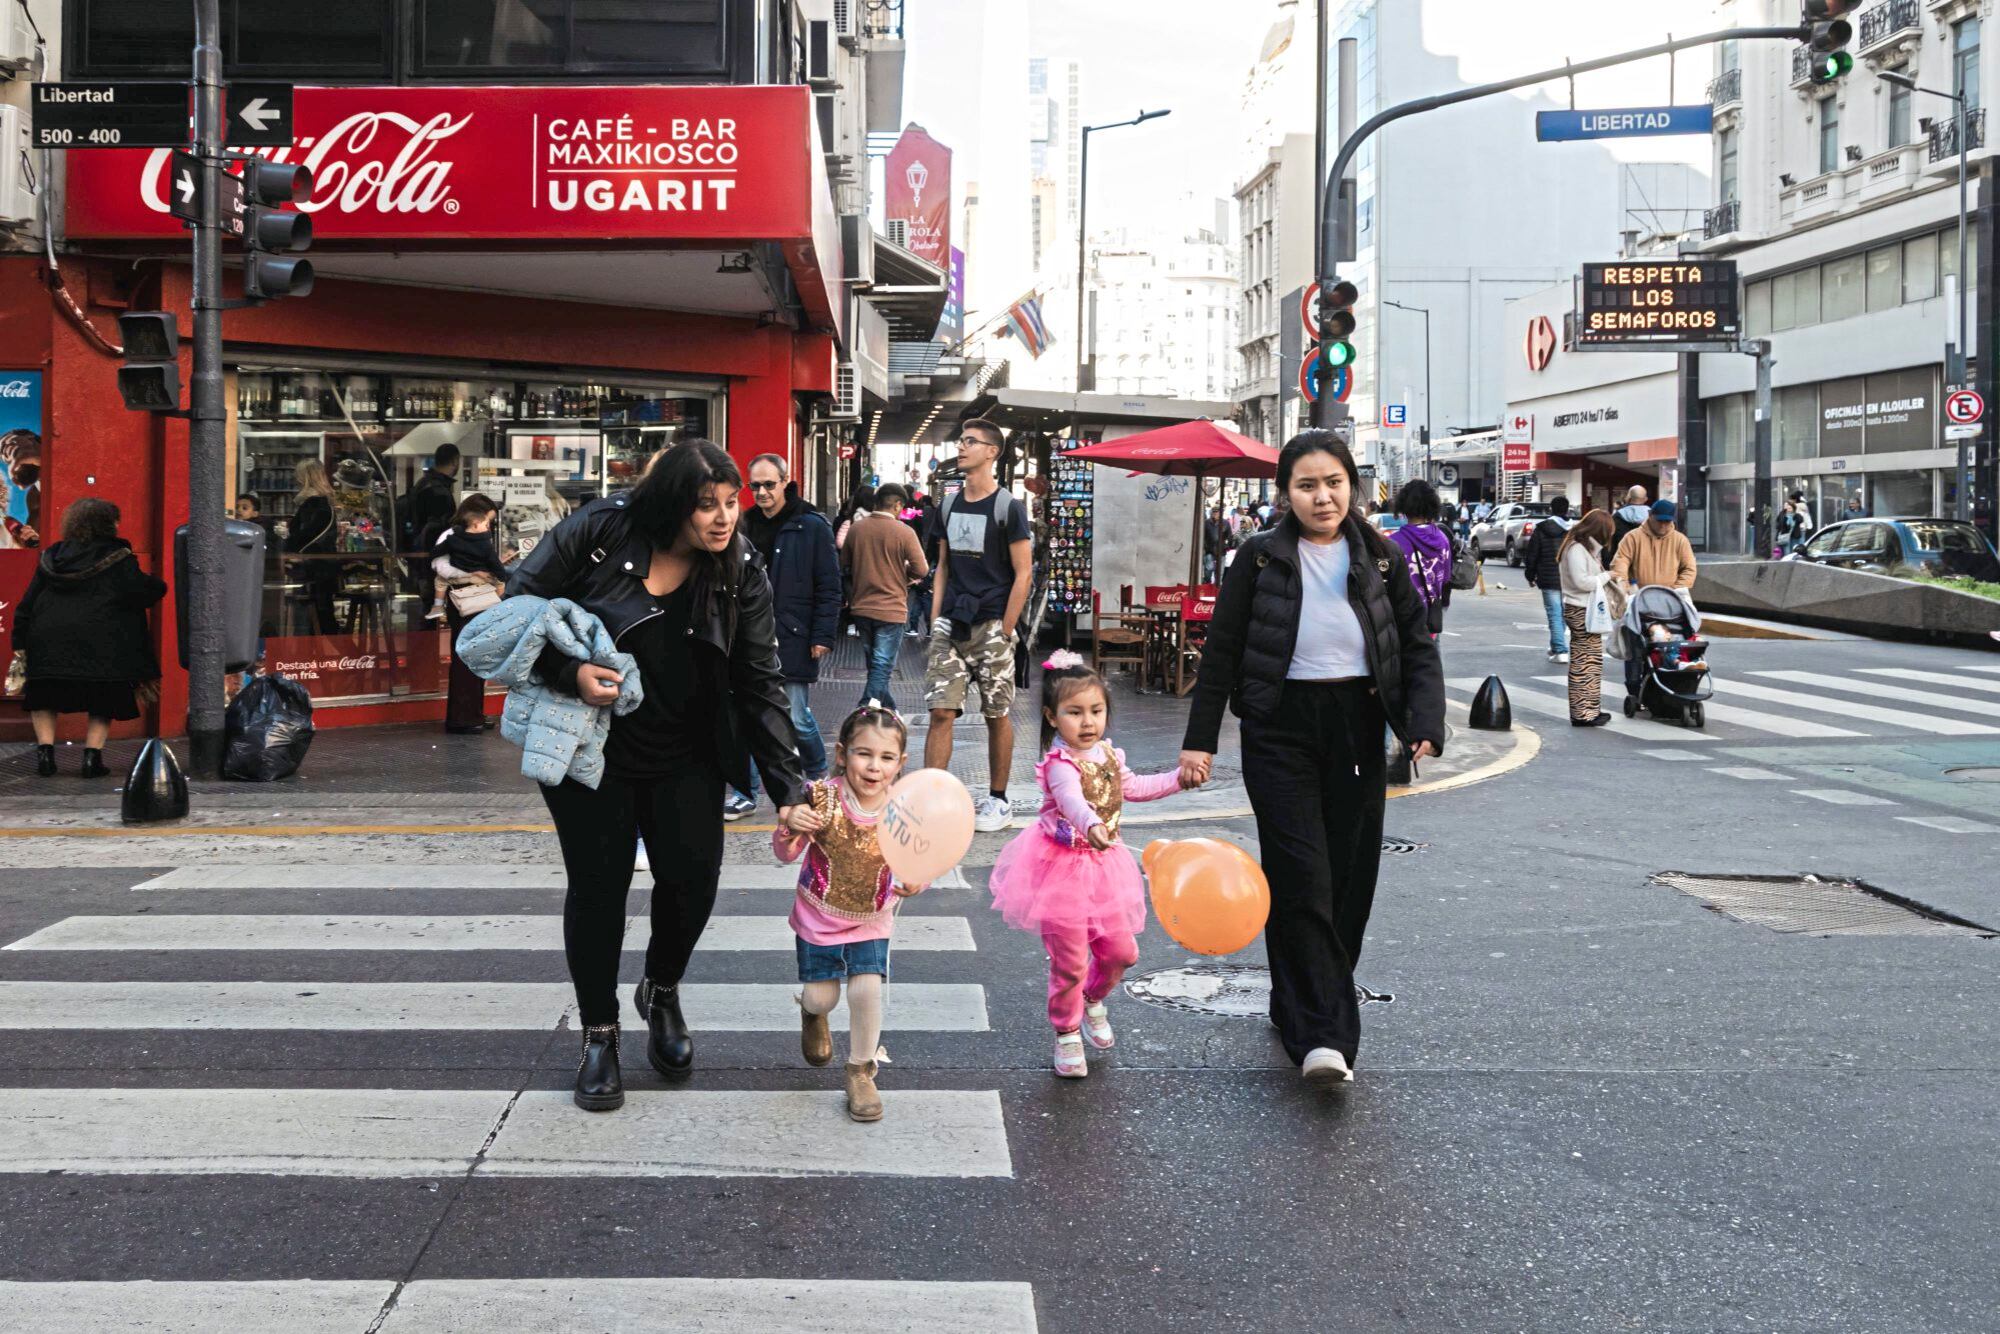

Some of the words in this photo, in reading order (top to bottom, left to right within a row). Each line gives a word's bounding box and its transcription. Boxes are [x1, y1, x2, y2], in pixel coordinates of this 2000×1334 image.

[40, 88, 114, 103] Libertad
[548, 113, 634, 141] CAFÉ
[671, 119, 736, 140] BAR
[1581, 113, 1671, 132] LIBERTAD
[40, 128, 73, 143] 500
[88, 128, 121, 143] 400
[548, 142, 739, 165] MAXIKIOSCO
[548, 179, 736, 211] UGARIT
[910, 215, 925, 224] LA
[1604, 267, 1701, 285] RESPETA
[1632, 289, 1674, 307] LOS
[1590, 310, 1717, 329] SEMAFOROS
[1825, 405, 1863, 419] OFICINAS
[1866, 403, 1878, 414] EN
[1880, 398, 1924, 412] ALQUILER
[1553, 412, 1580, 428] ABIERTO
[1580, 410, 1588, 424] 24
[276, 659, 317, 671] Destapá
[318, 660, 337, 669] una
[338, 655, 376, 671] Coca-Cola
[282, 671, 299, 681] ien
[299, 670, 320, 680] fría.
